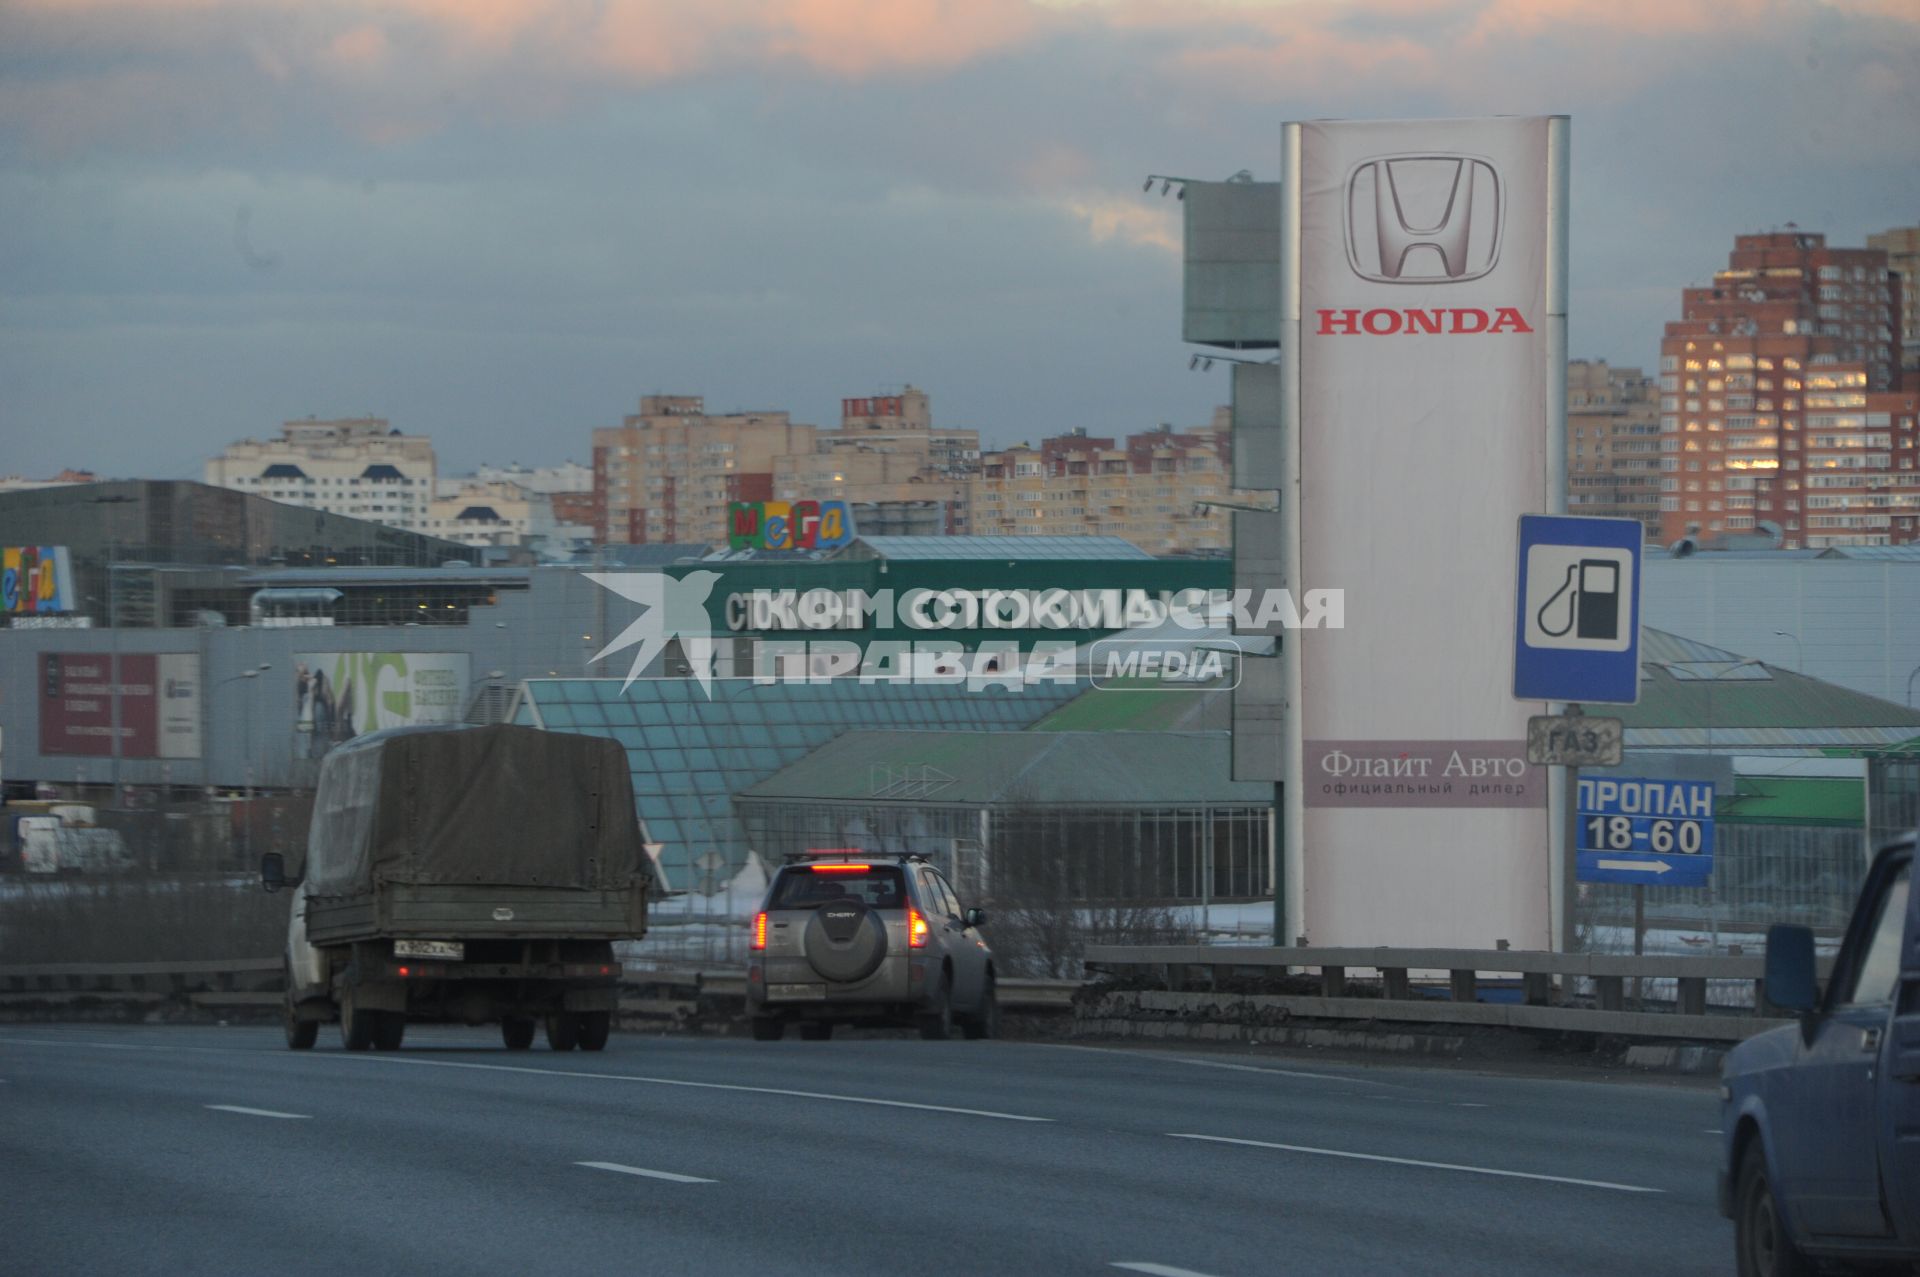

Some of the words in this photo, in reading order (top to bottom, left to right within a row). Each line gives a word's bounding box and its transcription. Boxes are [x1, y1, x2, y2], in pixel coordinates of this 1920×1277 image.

[1316, 307, 1534, 336] HONDA
[1548, 730, 1600, 753] ГАЗ
[1321, 749, 1432, 778] Флайт
[1442, 750, 1526, 778] Авто
[1322, 782, 1452, 797] официальный
[1468, 783, 1526, 797] дилер
[1577, 780, 1712, 817] ПРОПАН
[1588, 817, 1702, 854] 18-60
